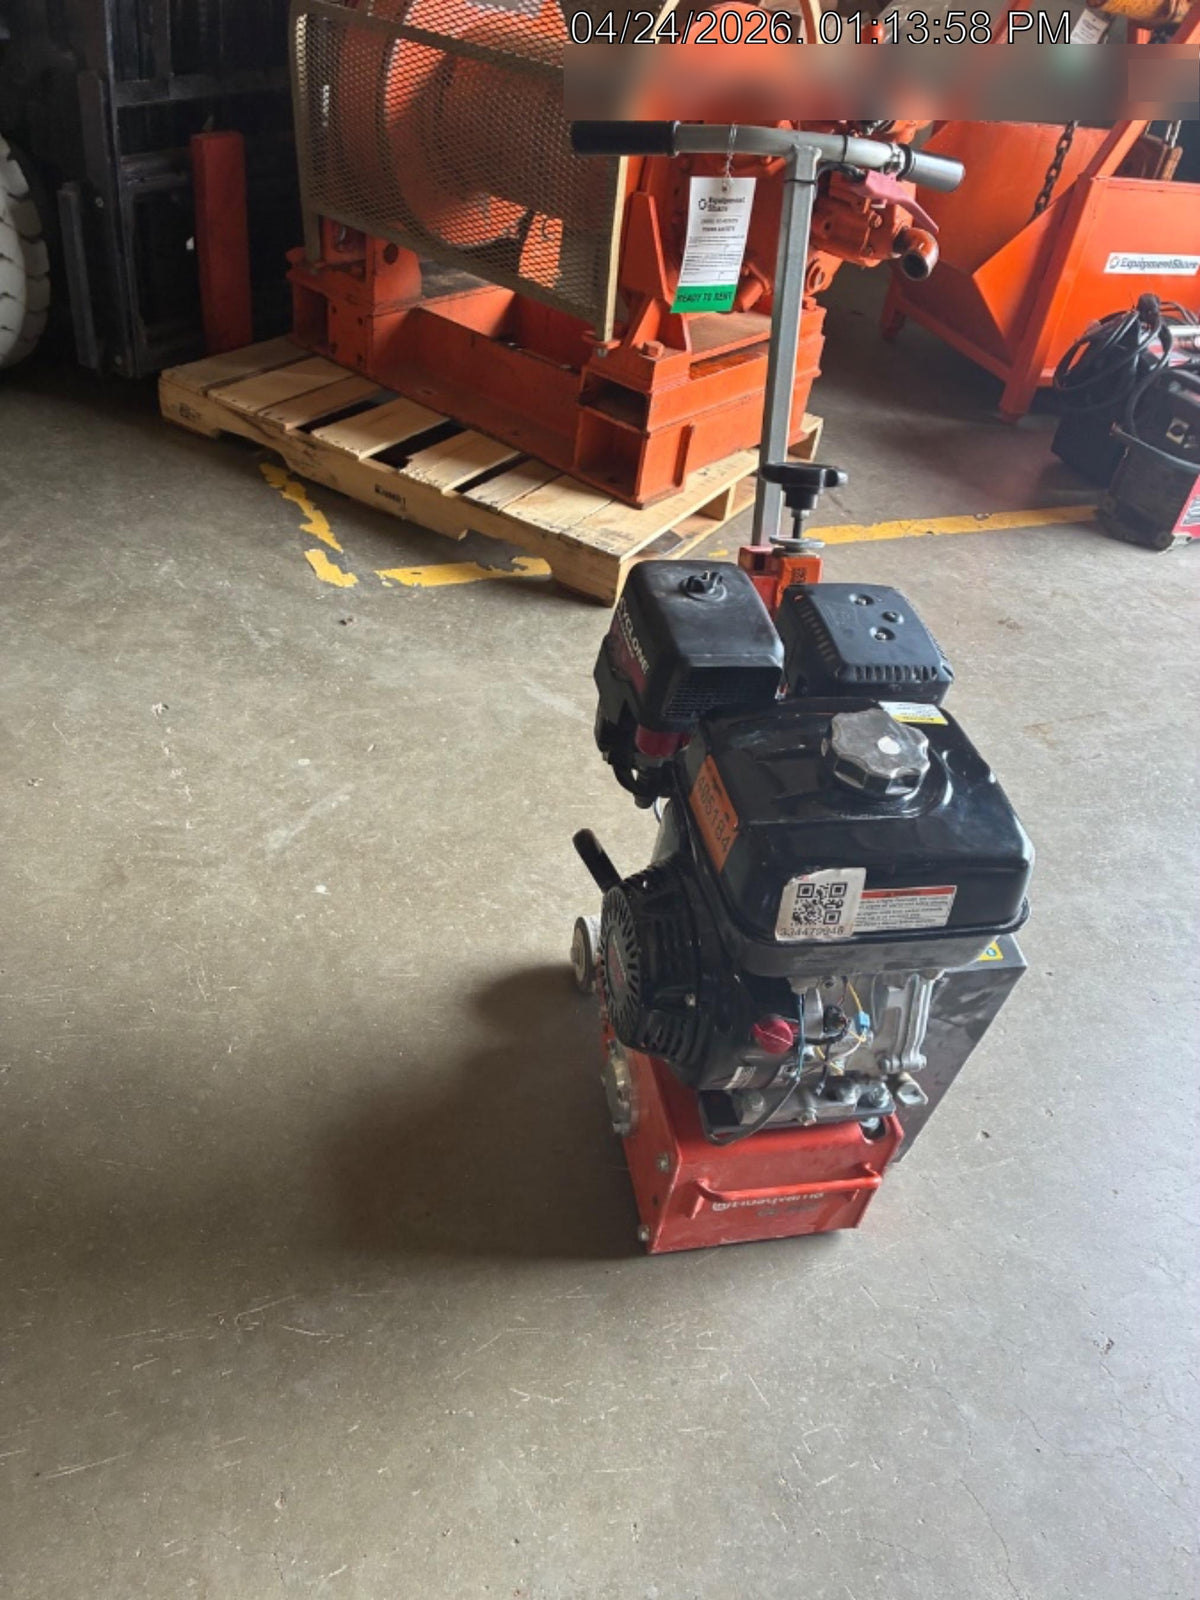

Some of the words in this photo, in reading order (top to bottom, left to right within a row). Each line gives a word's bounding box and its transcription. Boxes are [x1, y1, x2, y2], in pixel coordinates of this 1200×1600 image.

[1120, 257, 1198, 270] EquipmentShare
[677, 292, 702, 303] READY
[703, 292, 712, 302] TO
[714, 291, 733, 302] RENT
